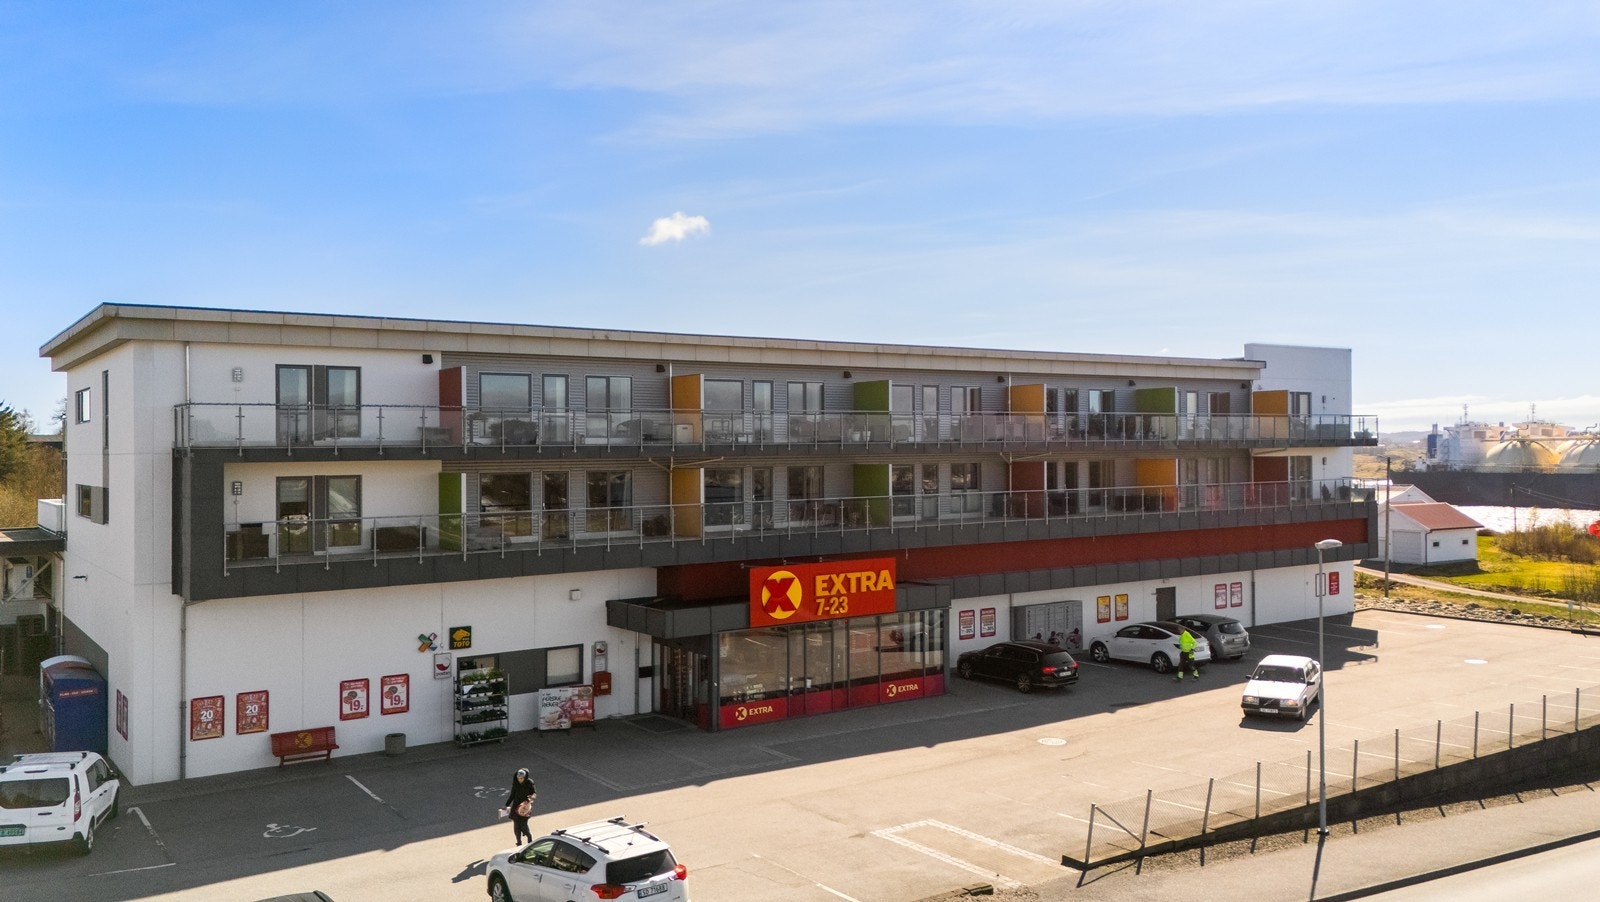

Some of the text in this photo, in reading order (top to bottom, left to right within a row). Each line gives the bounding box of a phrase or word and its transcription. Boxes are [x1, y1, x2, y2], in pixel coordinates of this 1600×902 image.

[815, 569, 895, 596] EXTRA
[815, 596, 849, 616] 7-23
[453, 640, 471, 648] TOTO
[897, 683, 918, 693] EXTRA
[246, 704, 258, 714] 20
[749, 705, 773, 716] EXTRA
[200, 710, 214, 720] 20
